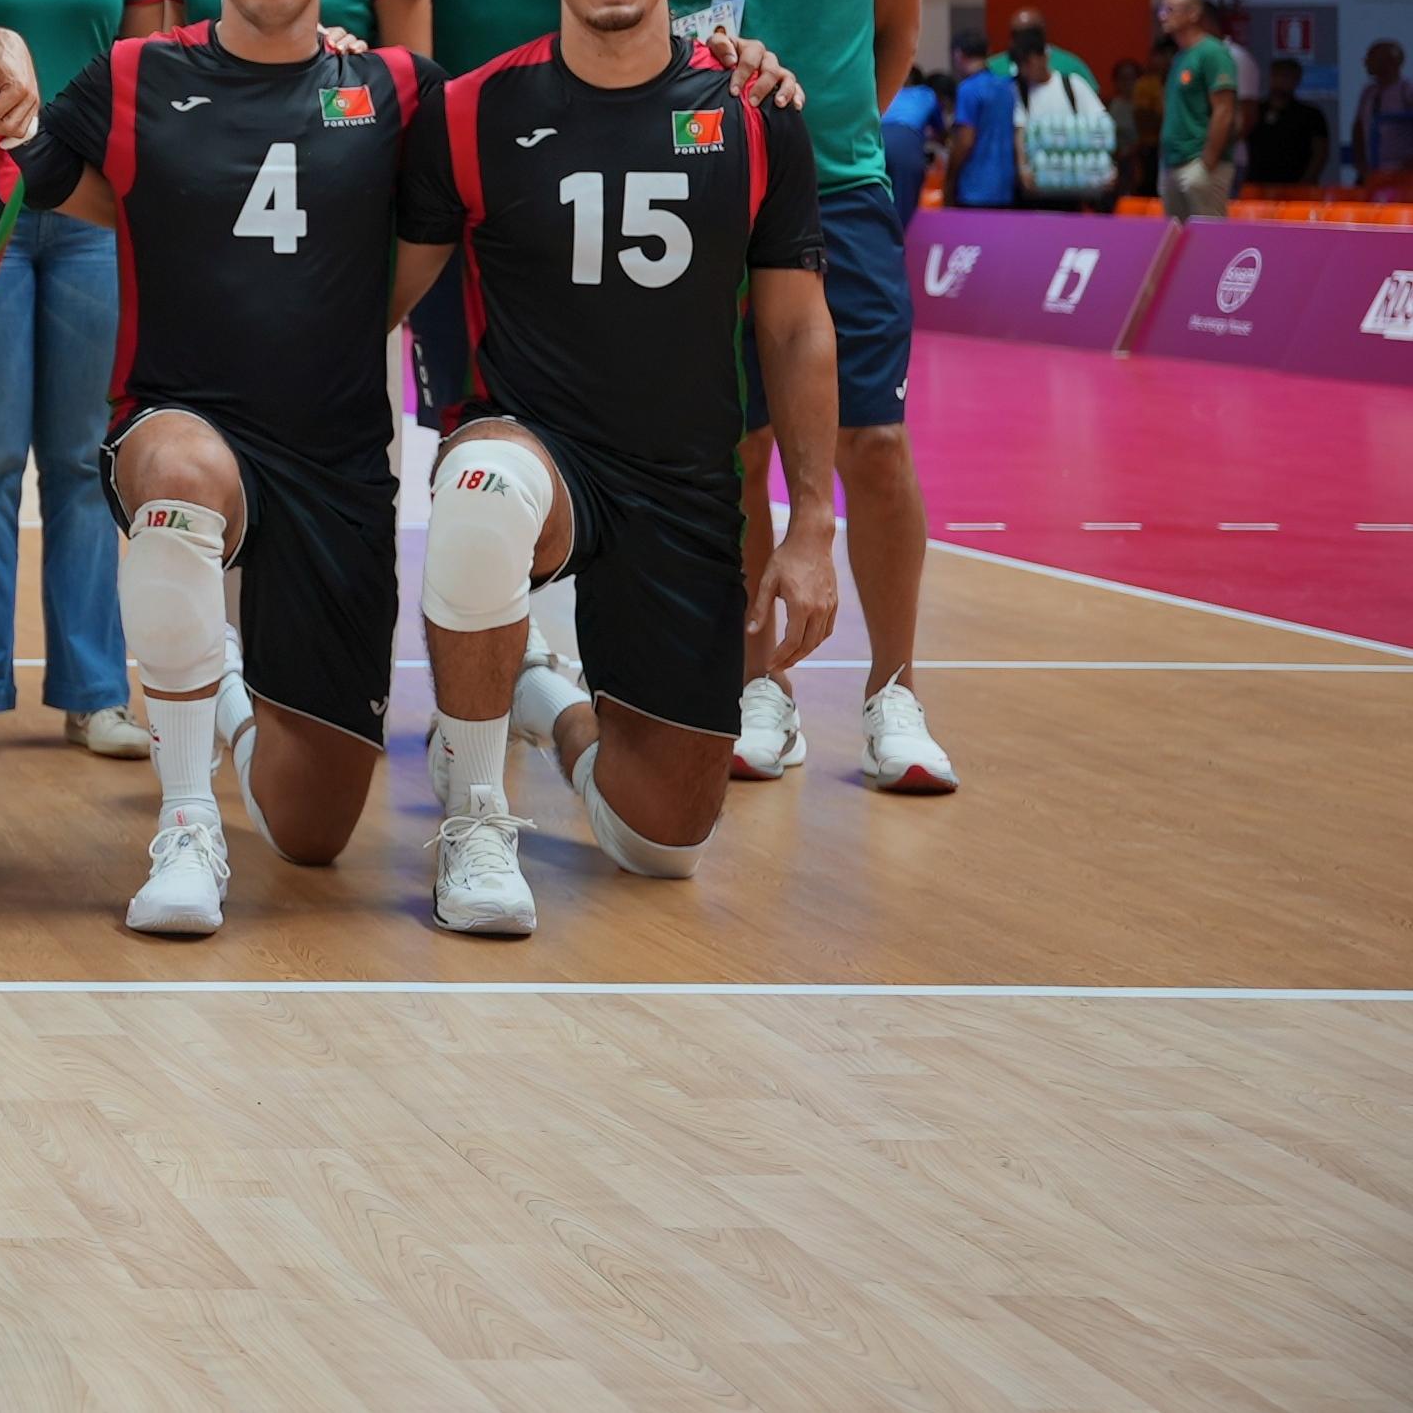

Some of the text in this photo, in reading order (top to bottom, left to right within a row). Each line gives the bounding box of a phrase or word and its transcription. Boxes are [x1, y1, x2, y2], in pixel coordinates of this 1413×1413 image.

[324, 117, 377, 128] PORTUGAL
[673, 143, 725, 155] PORTUGAL
[232, 142, 308, 254] 4
[559, 172, 694, 288] 15
[457, 470, 496, 492] 181
[147, 509, 178, 528] 181
